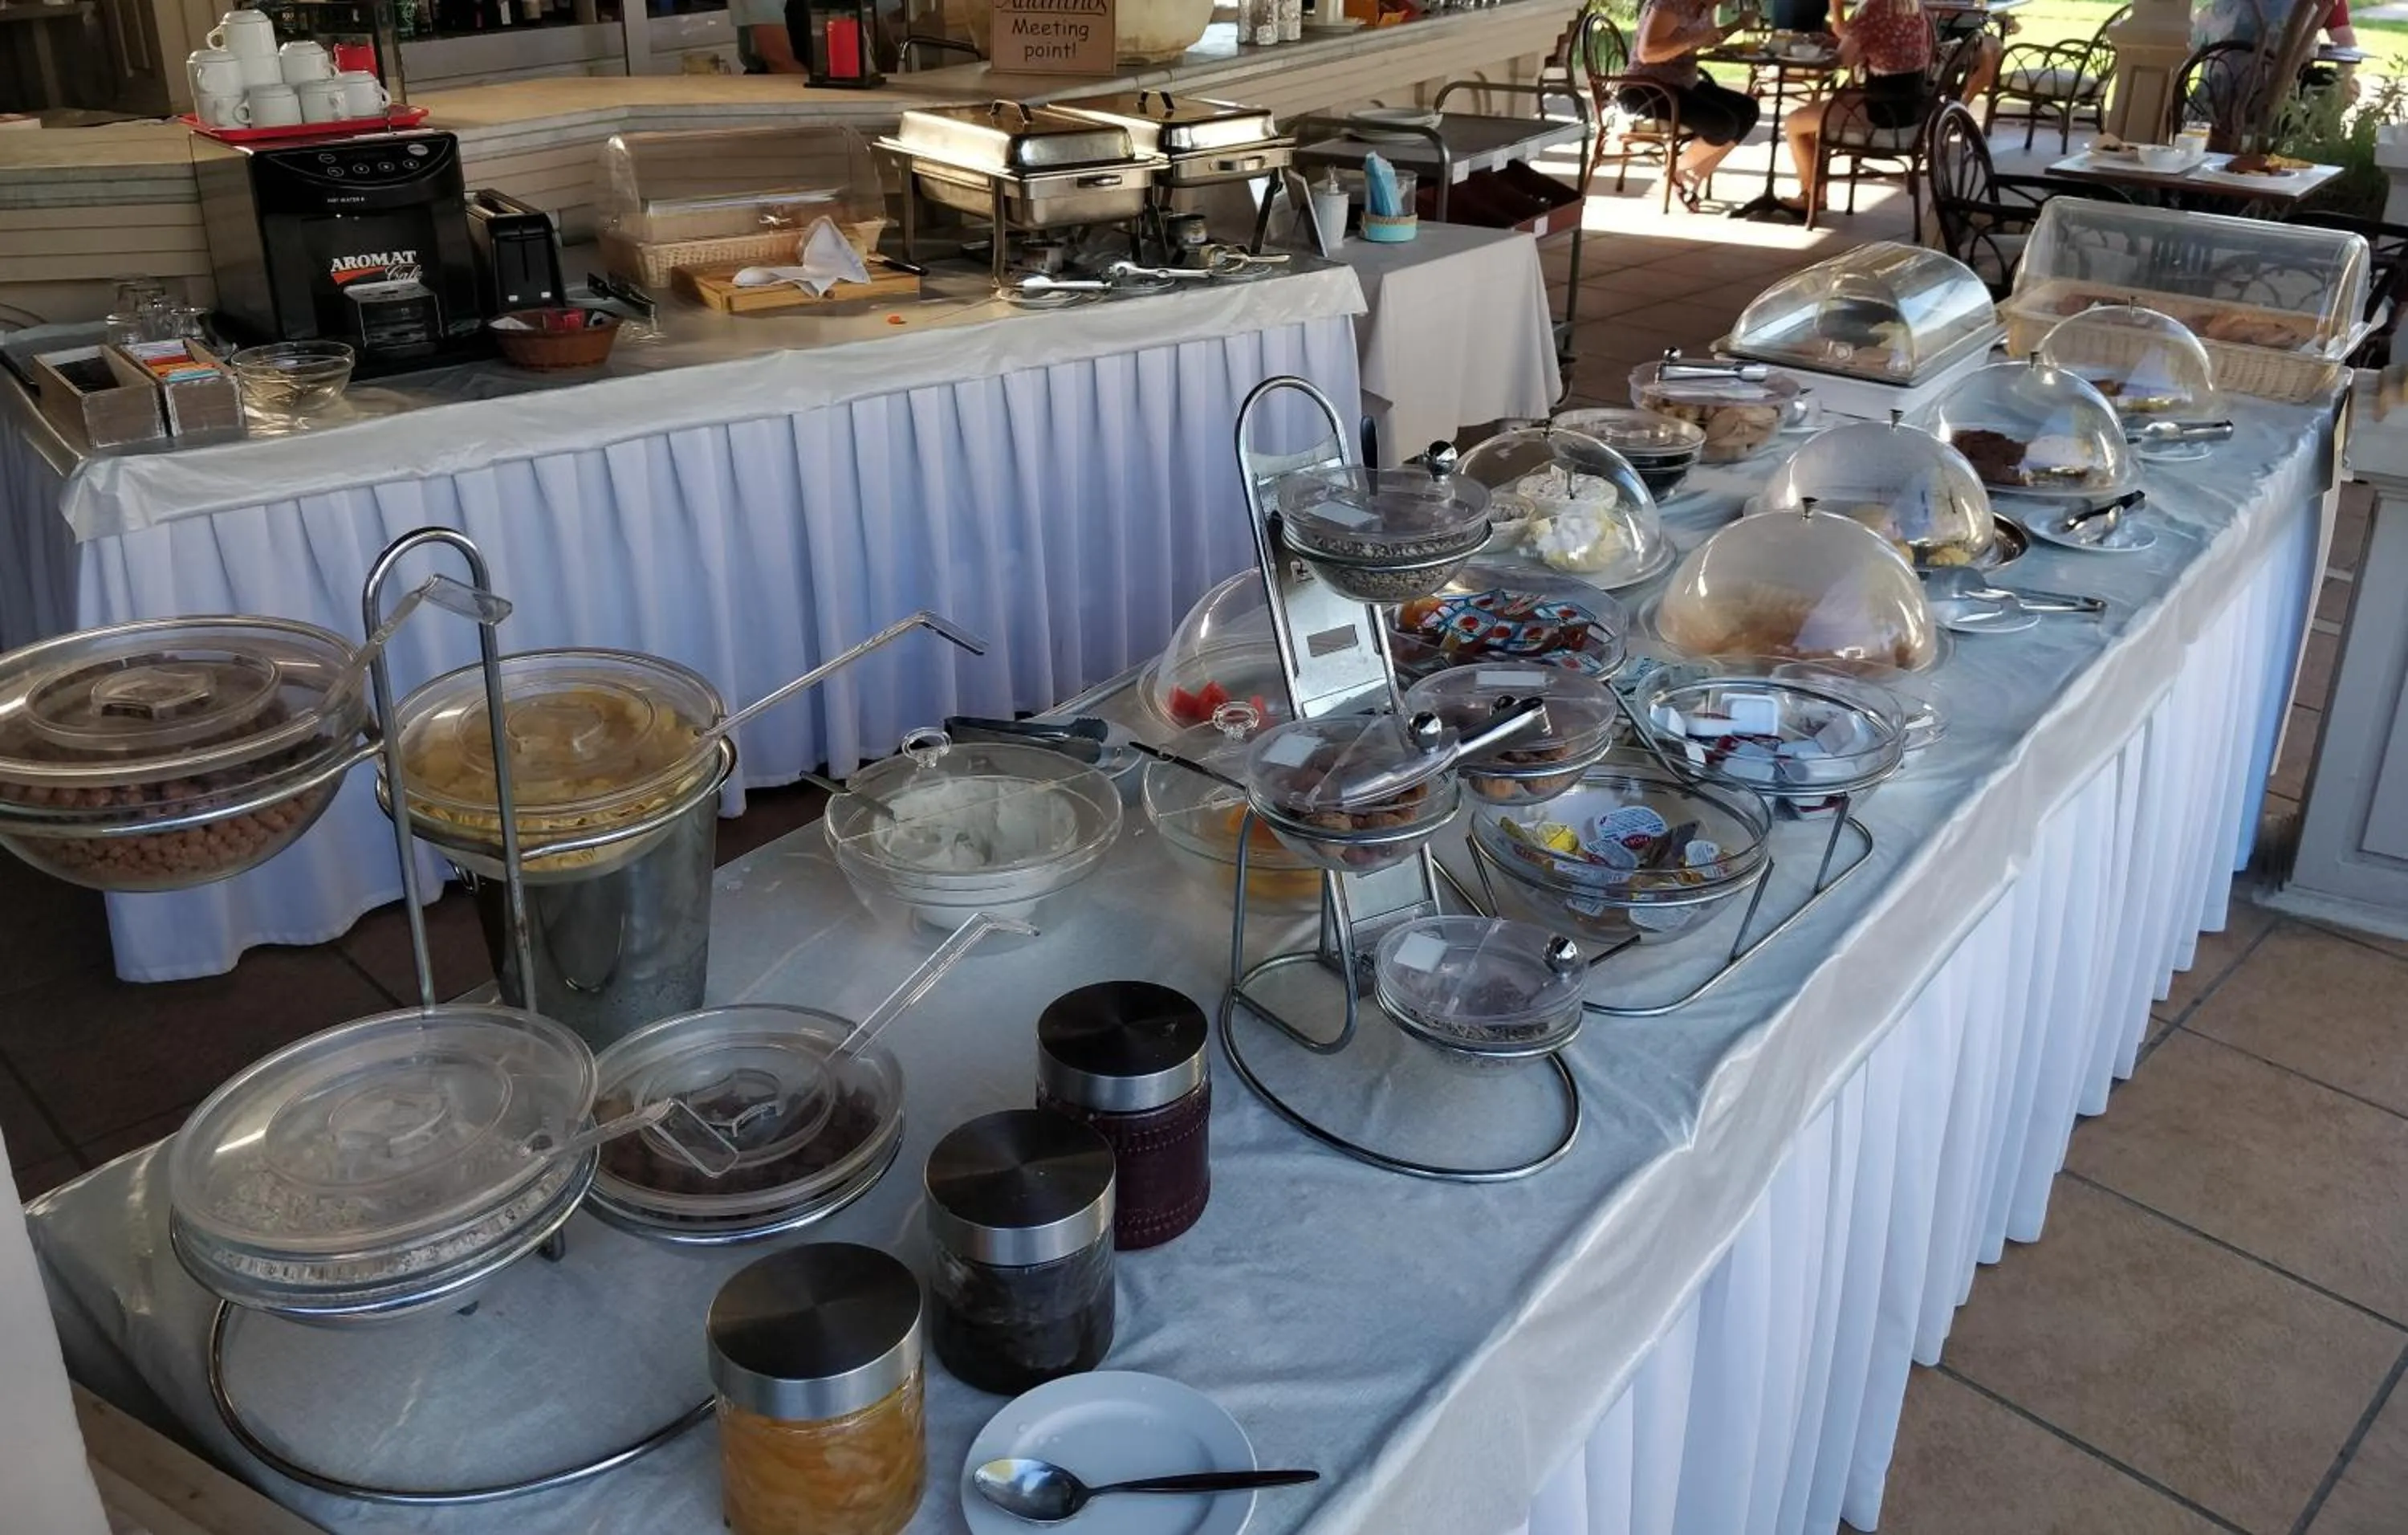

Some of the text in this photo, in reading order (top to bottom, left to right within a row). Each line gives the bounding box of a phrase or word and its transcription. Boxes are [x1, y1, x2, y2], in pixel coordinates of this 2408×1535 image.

[1011, 18, 1089, 42] Meeting
[1024, 43, 1077, 62] point!
[330, 250, 417, 272] AROMAT
